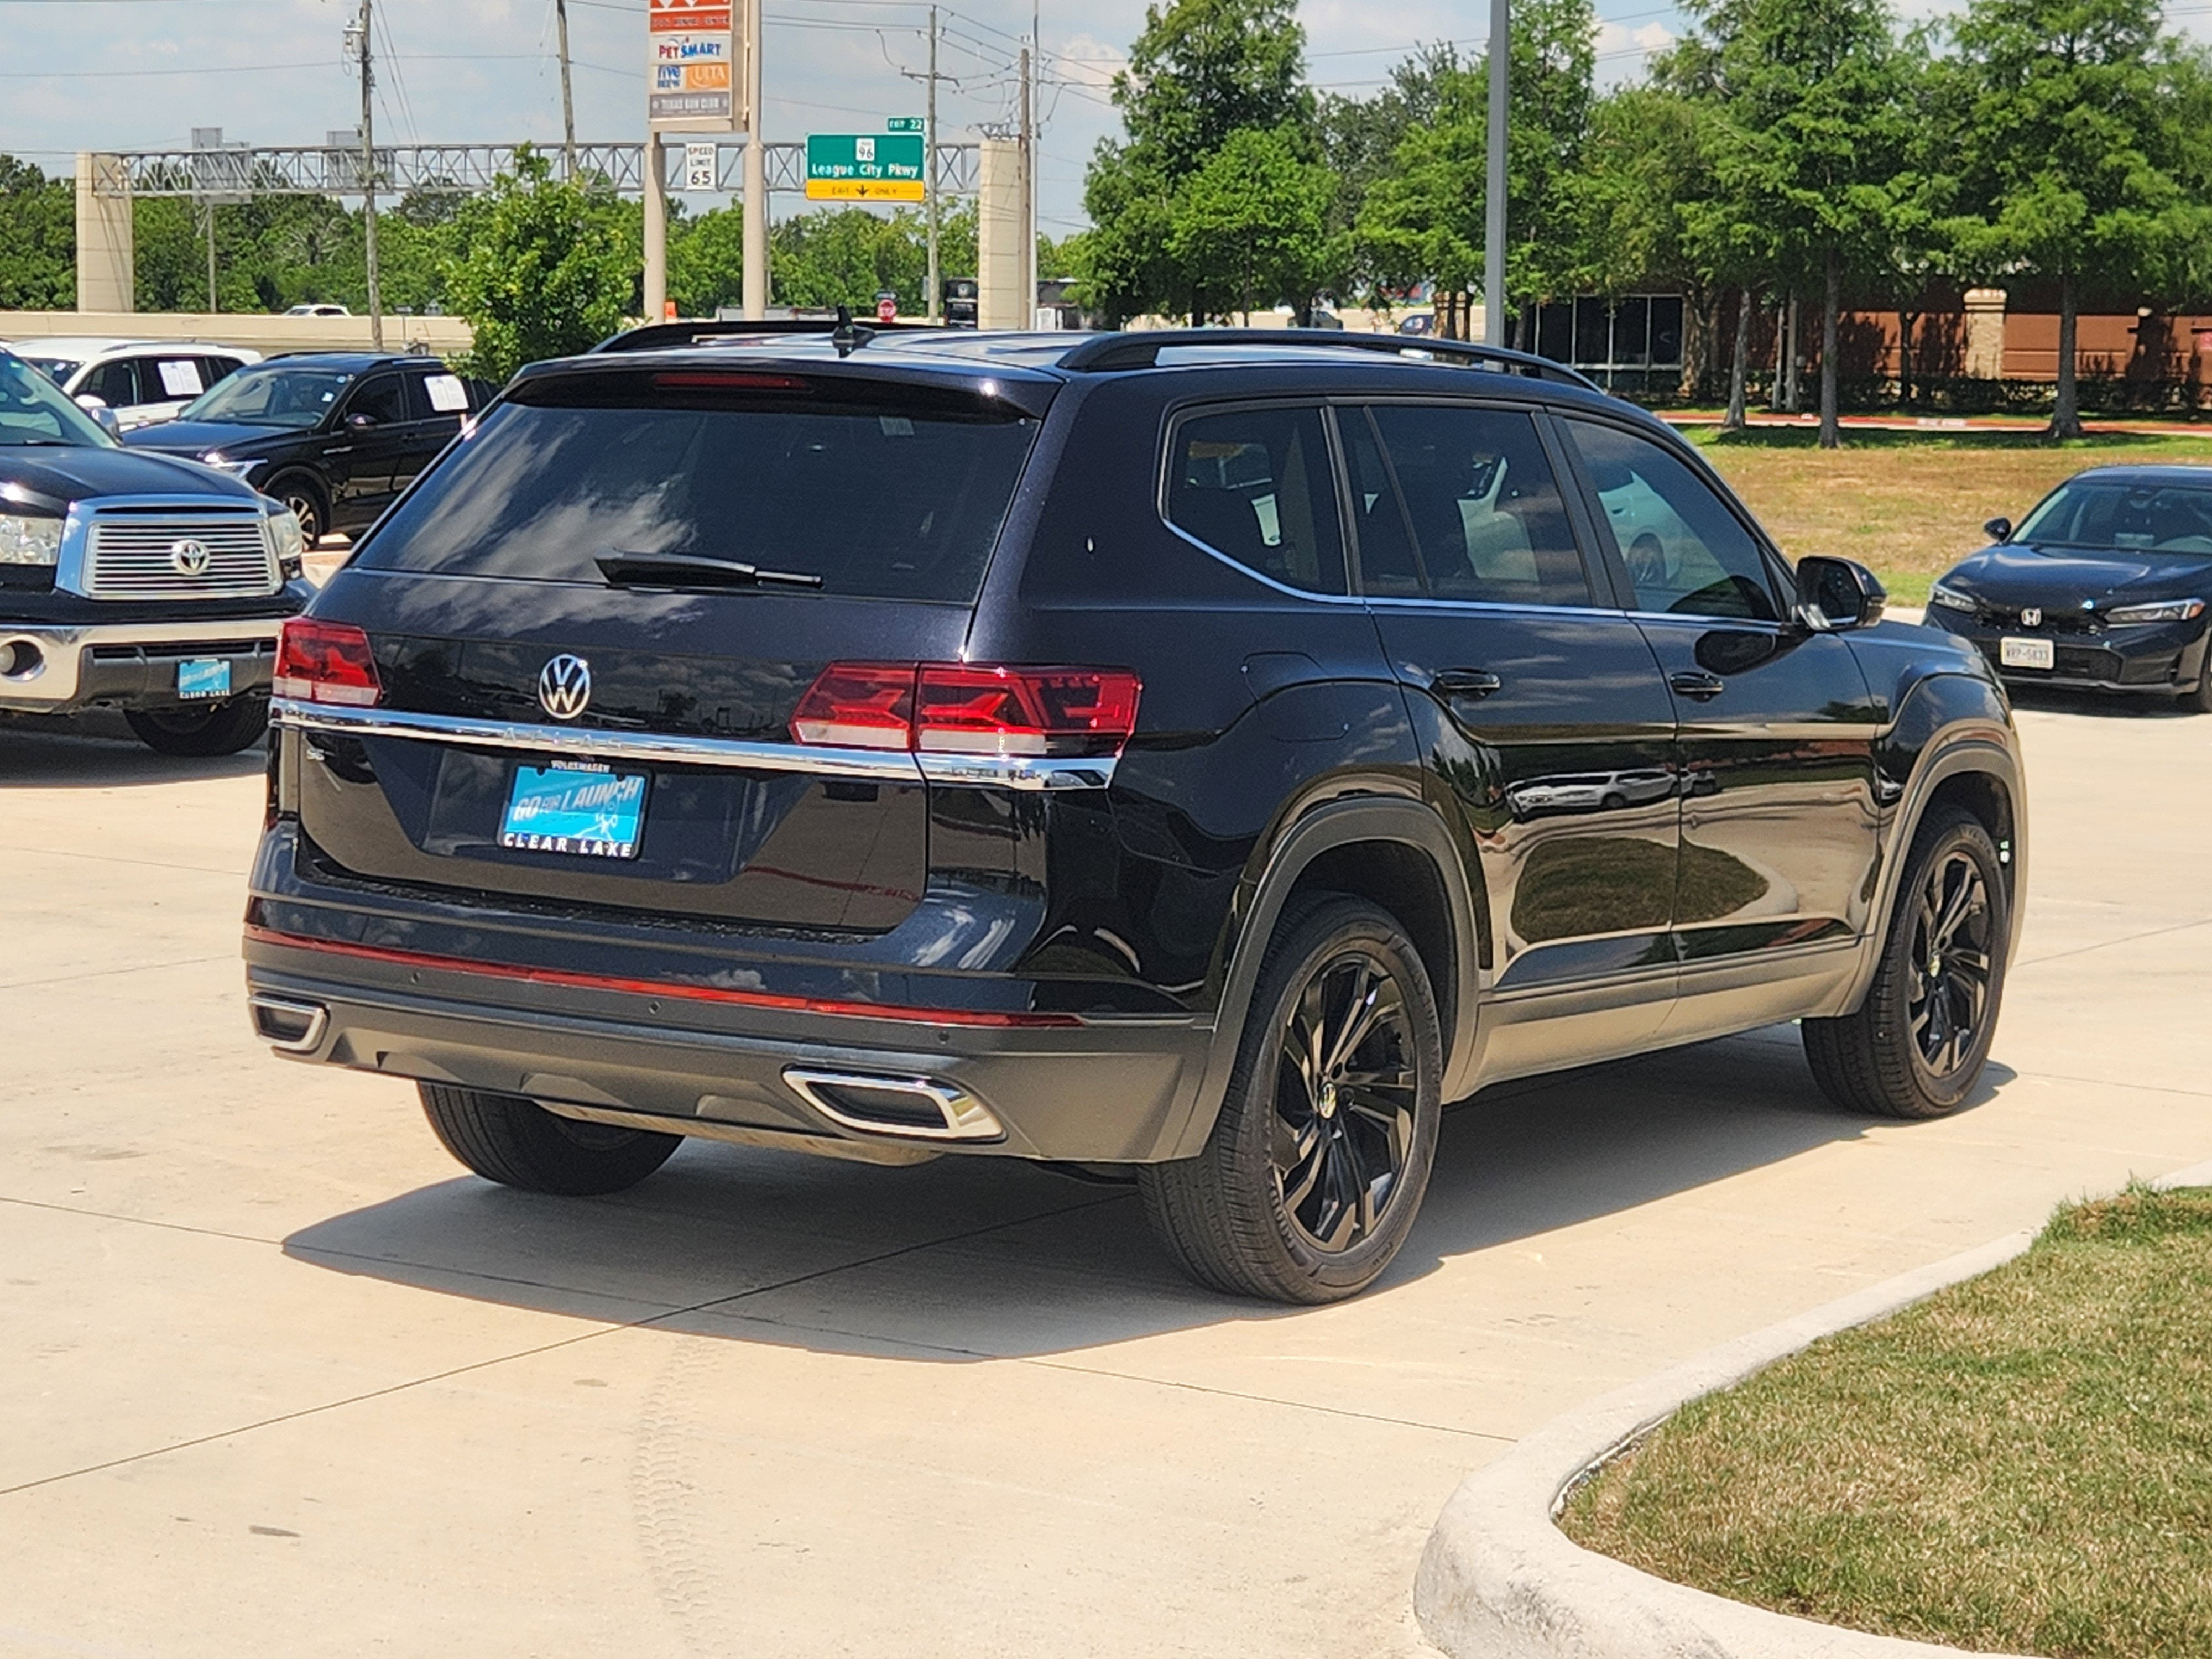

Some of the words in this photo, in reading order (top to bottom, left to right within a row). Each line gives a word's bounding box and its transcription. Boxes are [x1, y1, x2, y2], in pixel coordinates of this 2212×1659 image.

[910, 119, 922, 129] 22
[688, 147, 714, 155] SPEED
[859, 147, 873, 159] 96
[691, 170, 711, 185] 65
[812, 163, 854, 178] League
[859, 163, 883, 178] City
[888, 163, 918, 179] Pkwy
[561, 776, 644, 811] LAUNCH
[504, 833, 567, 852] CLEAR
[580, 839, 633, 857] LAKE
